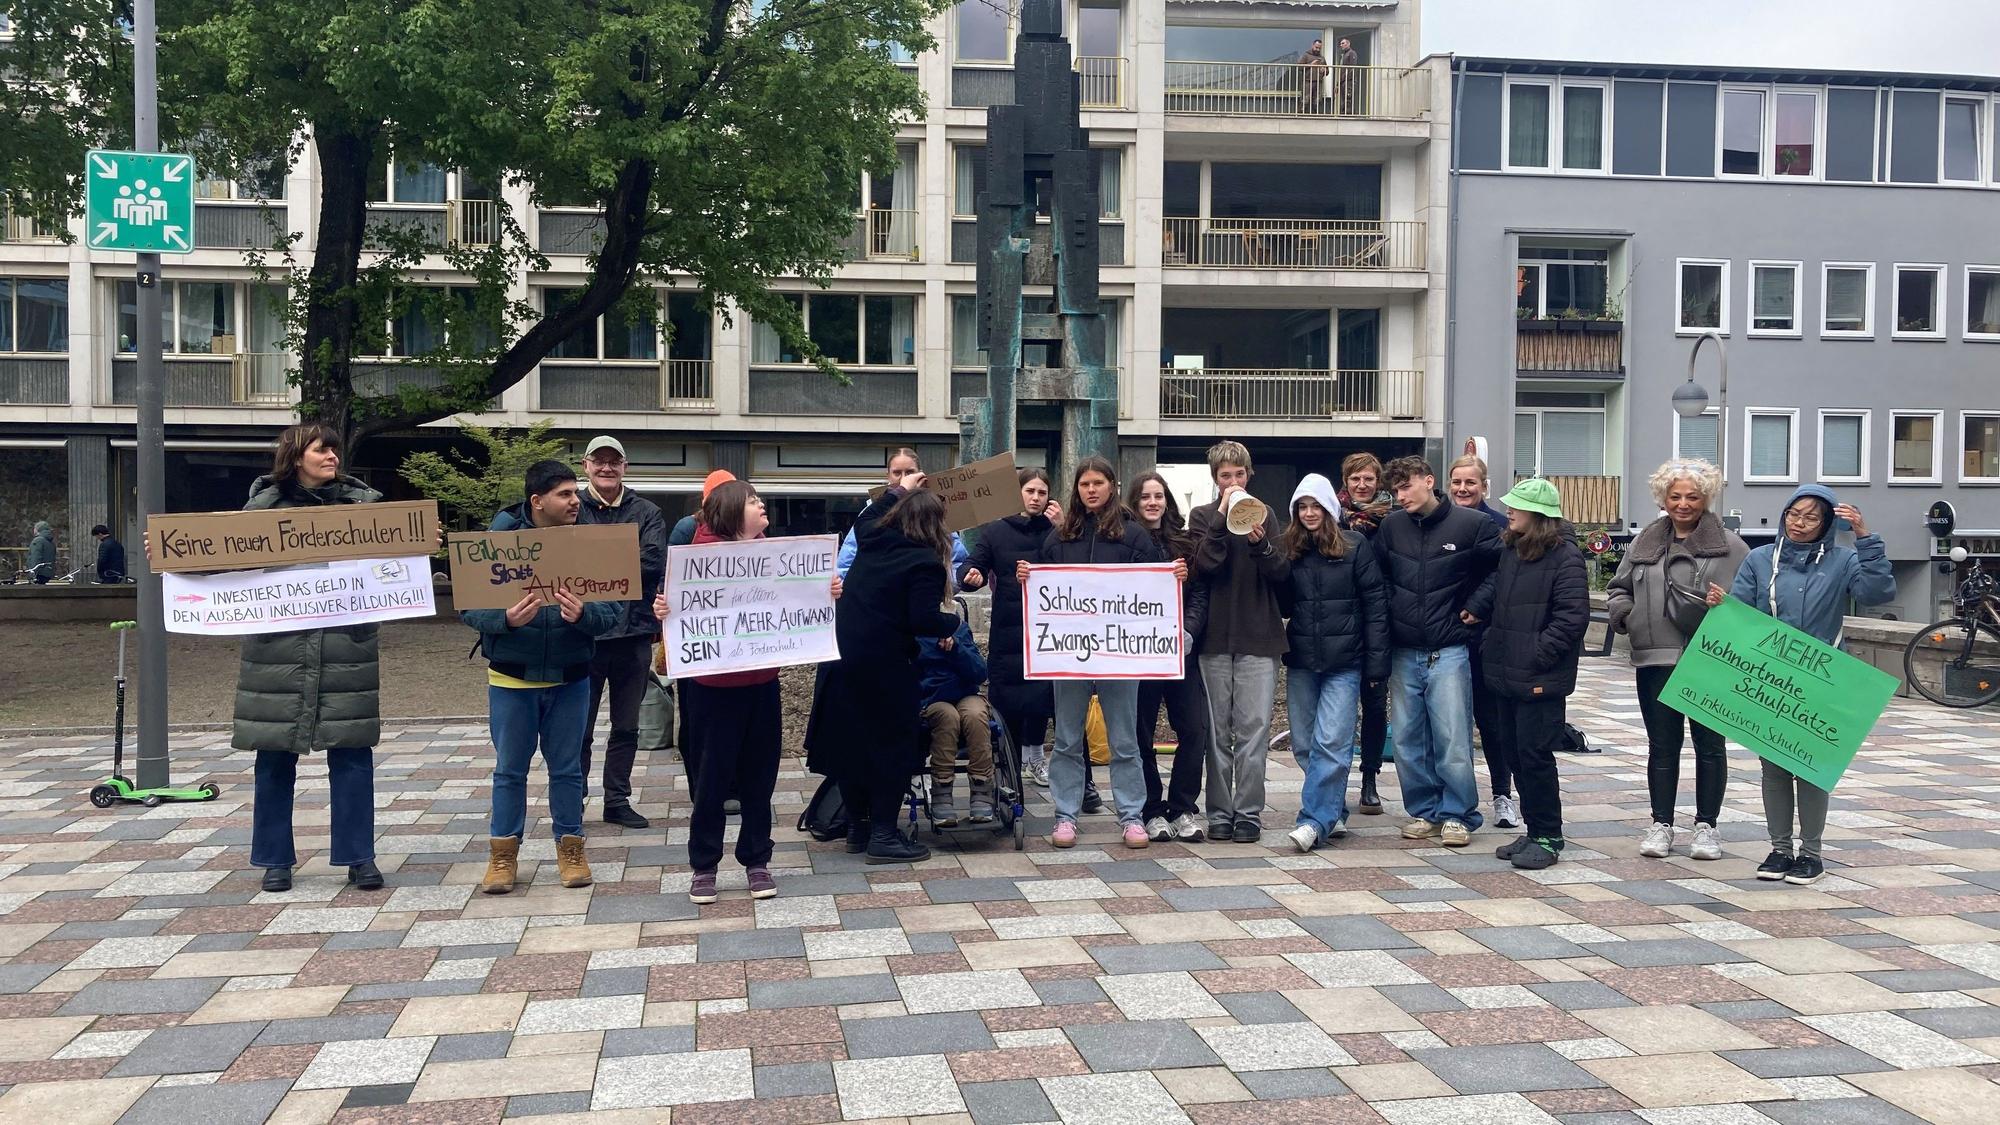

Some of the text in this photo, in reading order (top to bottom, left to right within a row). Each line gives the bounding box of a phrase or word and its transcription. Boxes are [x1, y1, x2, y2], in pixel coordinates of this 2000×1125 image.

[142, 274, 149, 284] 2
[973, 483, 992, 498] und
[160, 528, 216, 559] Keine
[224, 535, 273, 553] neuen
[448, 536, 543, 566] Teilhabe
[683, 552, 832, 581] INKLUSIVE SCHULE
[173, 588, 425, 623] DEN AUSBAU INKLUSIVER BILDUNG!!!
[212, 576, 365, 605] INVESTIERT DAS GELD IN
[681, 588, 725, 612] DARF
[1039, 585, 1164, 617] Schluss mit dem
[680, 606, 835, 640] NICHT MEHR AUFWAND
[680, 640, 721, 664] SEIN
[1757, 628, 1834, 679] MEHR
[1735, 677, 1840, 742] Schulplätze
[1681, 687, 1814, 766] an inklusiven Schulen
